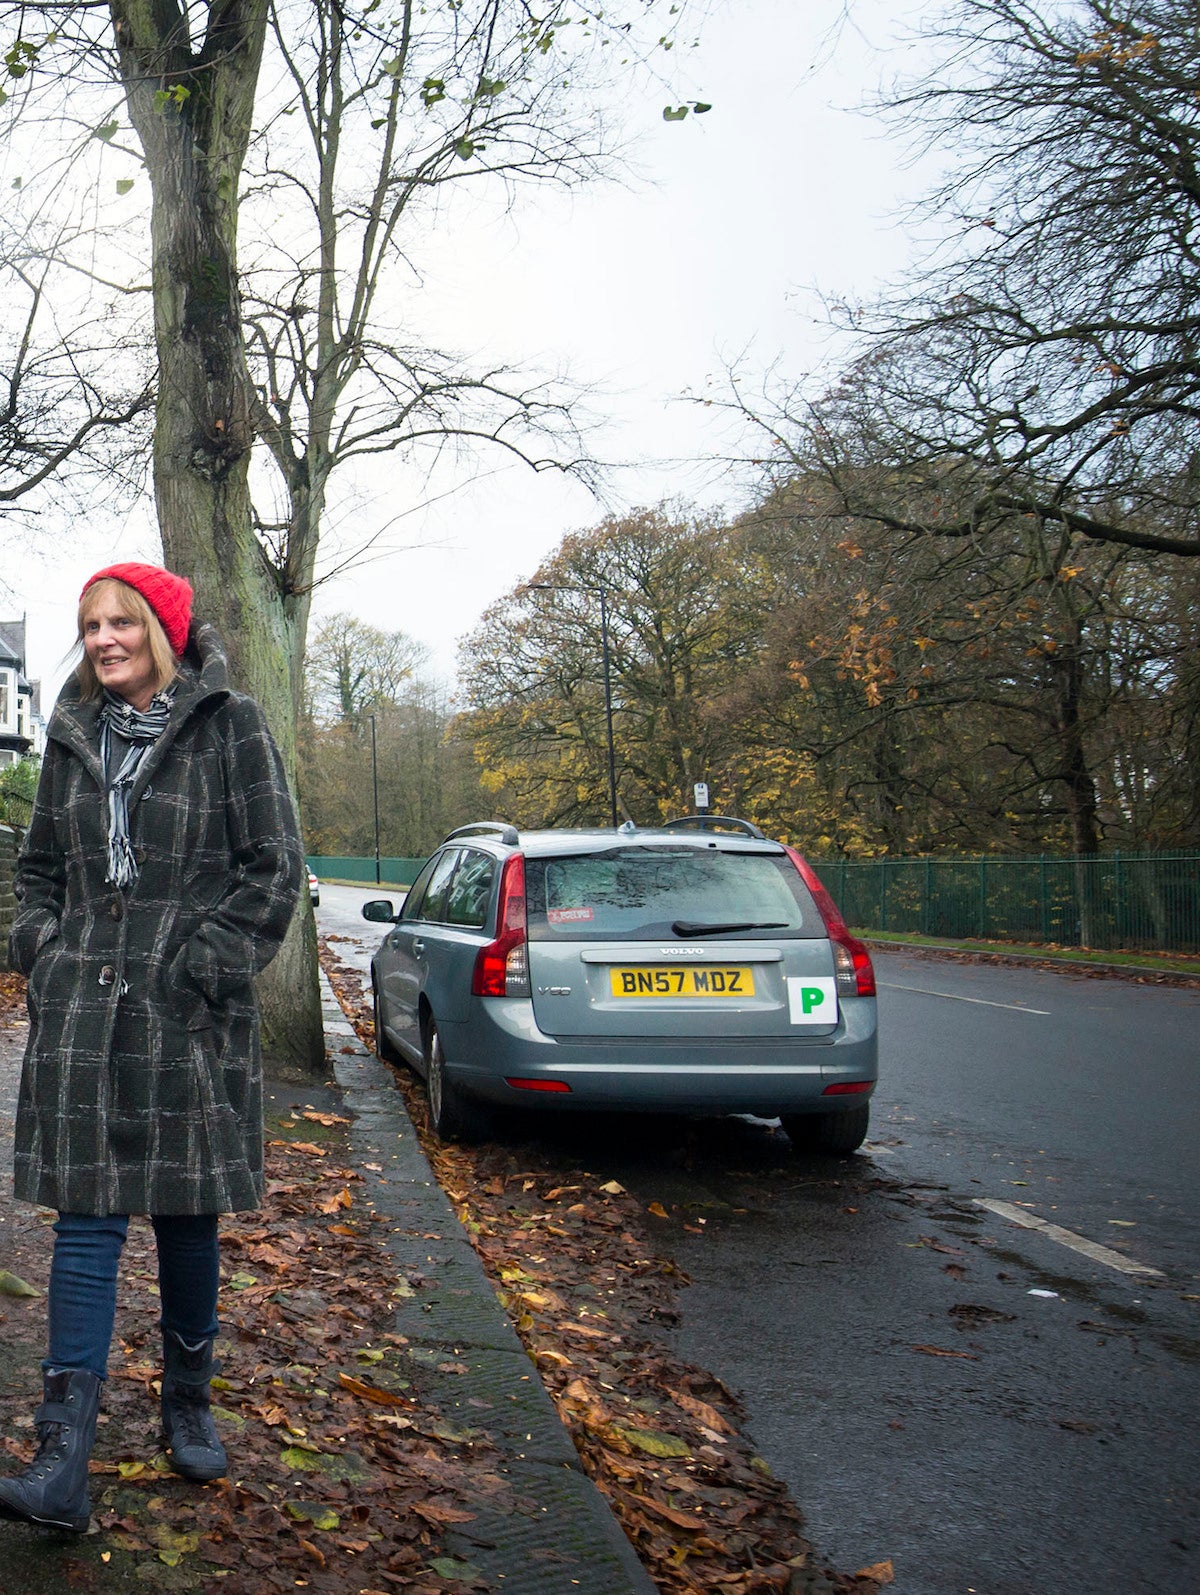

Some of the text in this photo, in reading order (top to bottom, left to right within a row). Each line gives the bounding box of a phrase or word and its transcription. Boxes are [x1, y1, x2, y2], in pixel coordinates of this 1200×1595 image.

[660, 947, 704, 955] VOLVO
[621, 971, 743, 992] BN57 MDZ
[800, 987, 825, 1014] P
